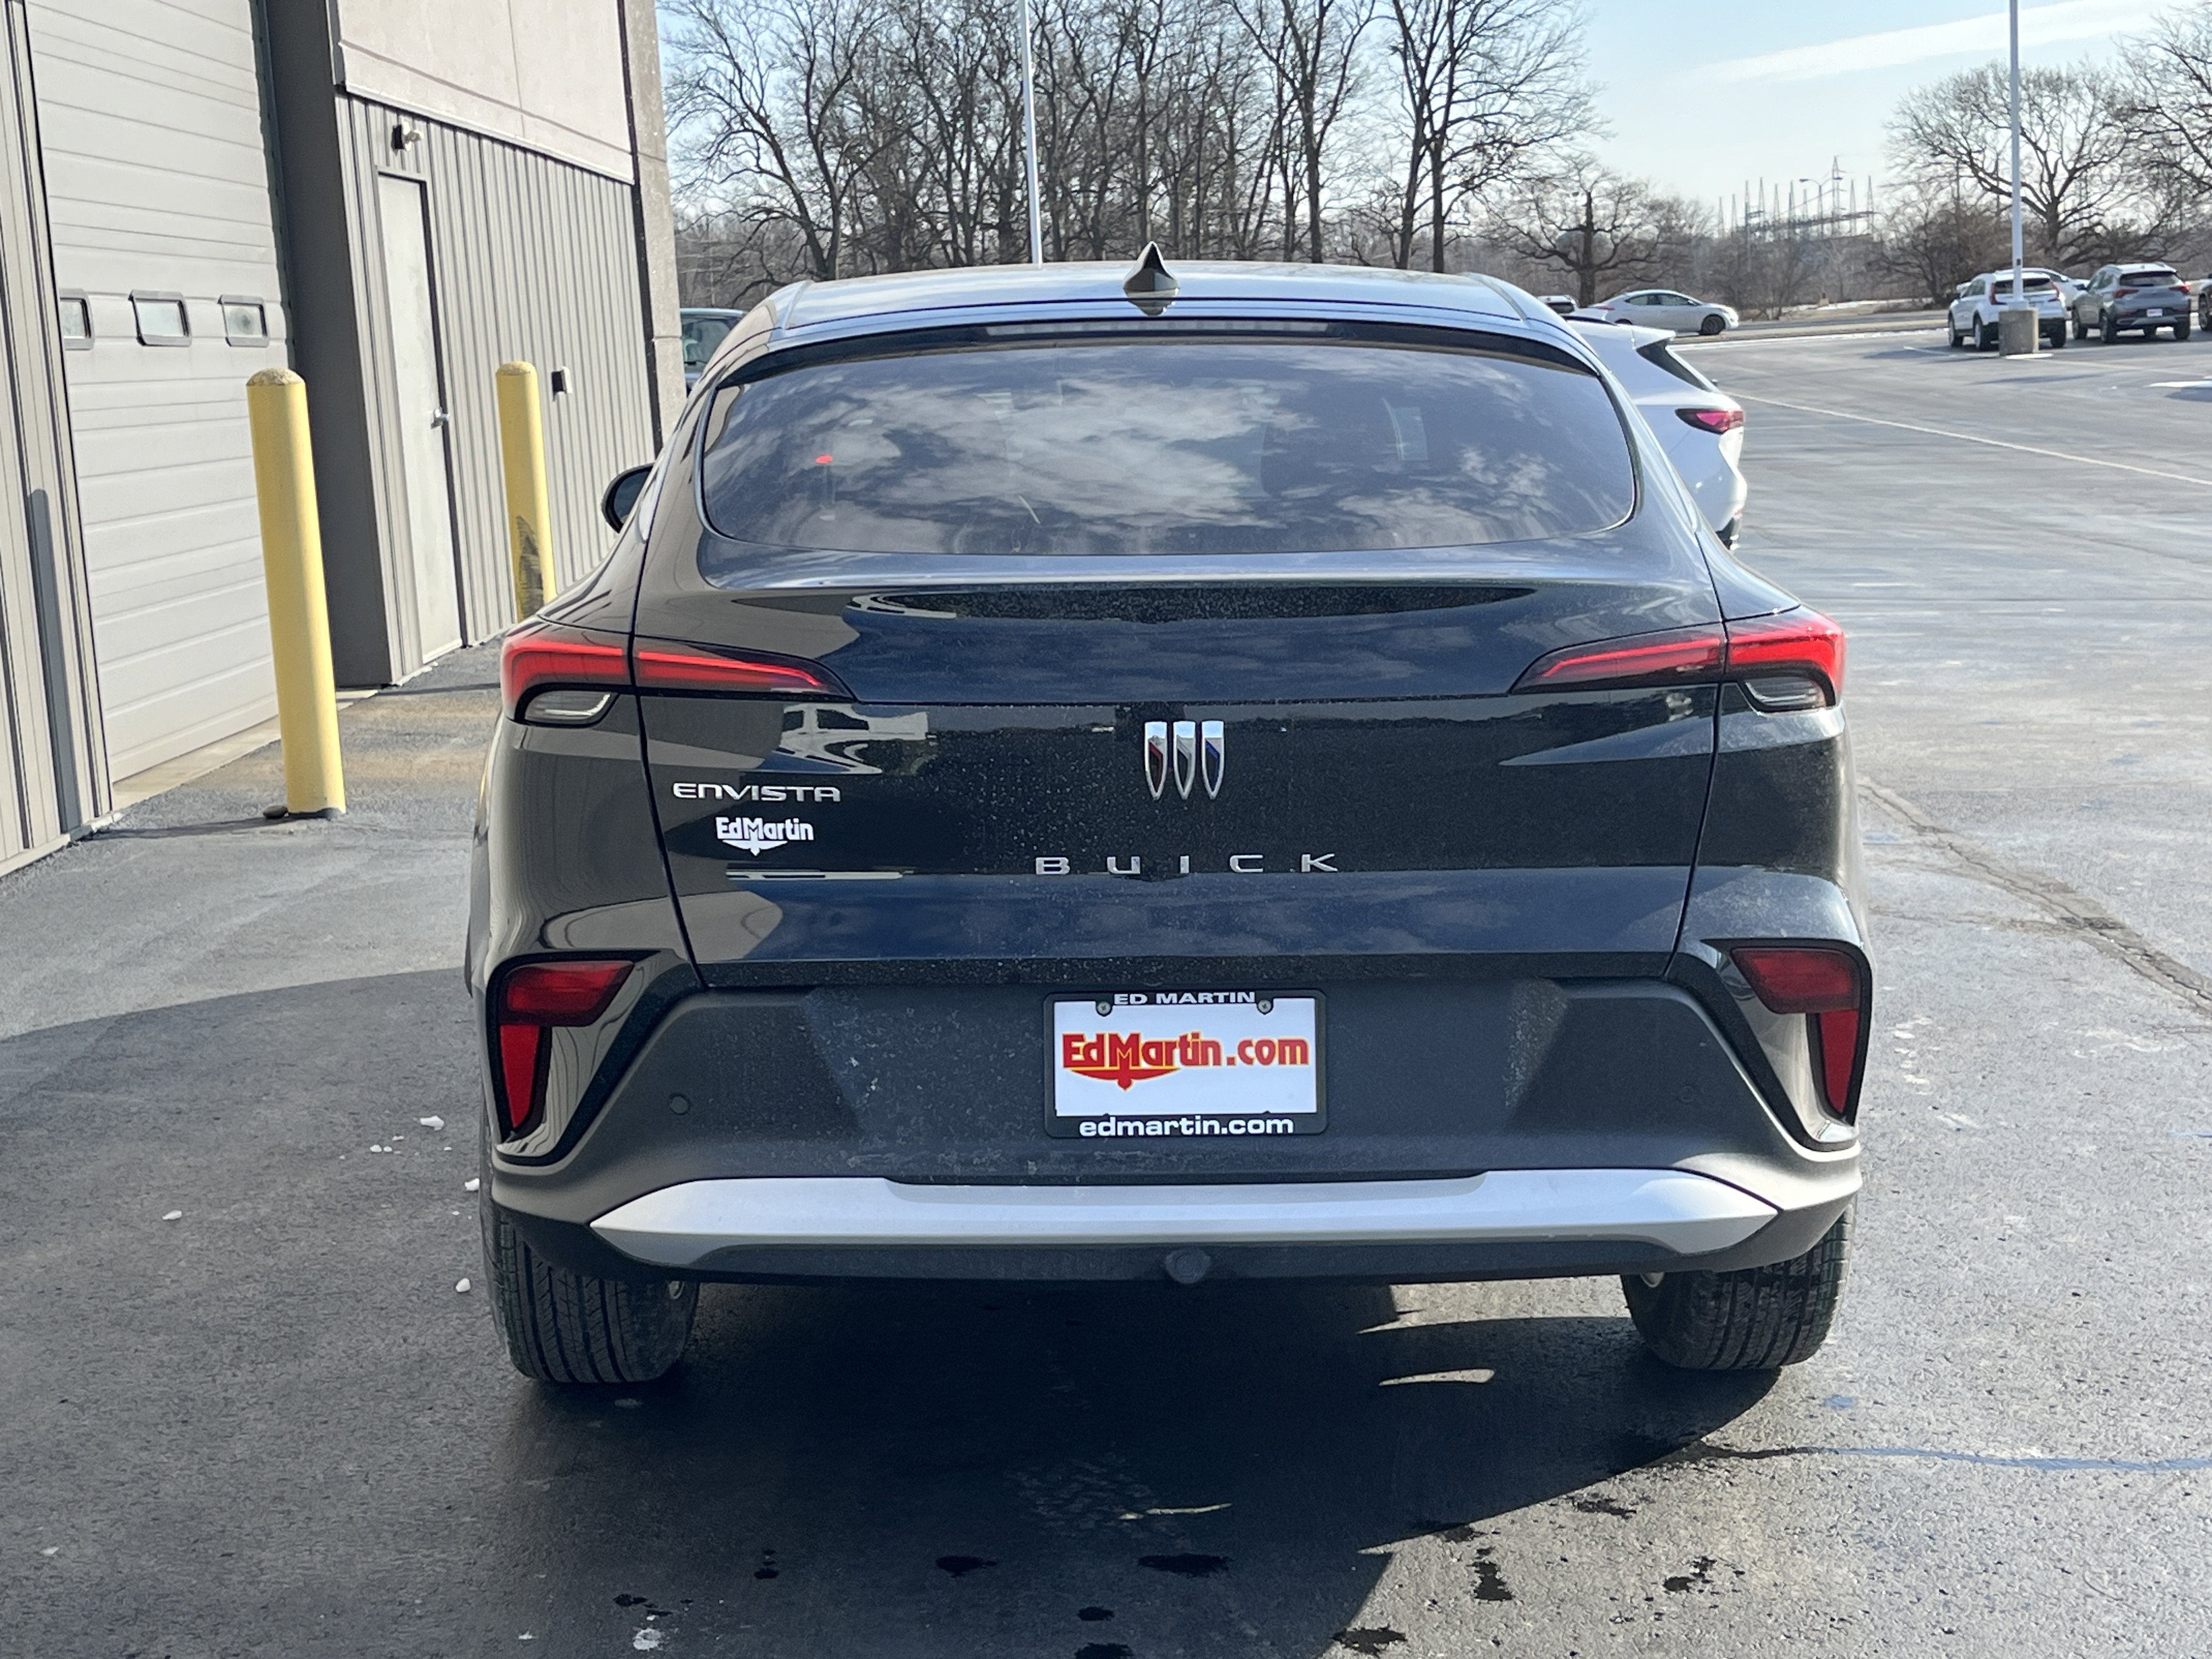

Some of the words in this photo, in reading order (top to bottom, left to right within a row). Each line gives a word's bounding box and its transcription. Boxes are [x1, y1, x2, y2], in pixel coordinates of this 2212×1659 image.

[673, 782, 841, 802] ENVISTA
[715, 816, 814, 841] EdMartin
[1035, 854, 1338, 875] BUICK
[1114, 993, 1148, 1006] ED
[1156, 991, 1256, 1004] MARTIN
[1062, 1031, 1310, 1068] EdMartin.com
[1079, 1115, 1294, 1136] edmartin.com
